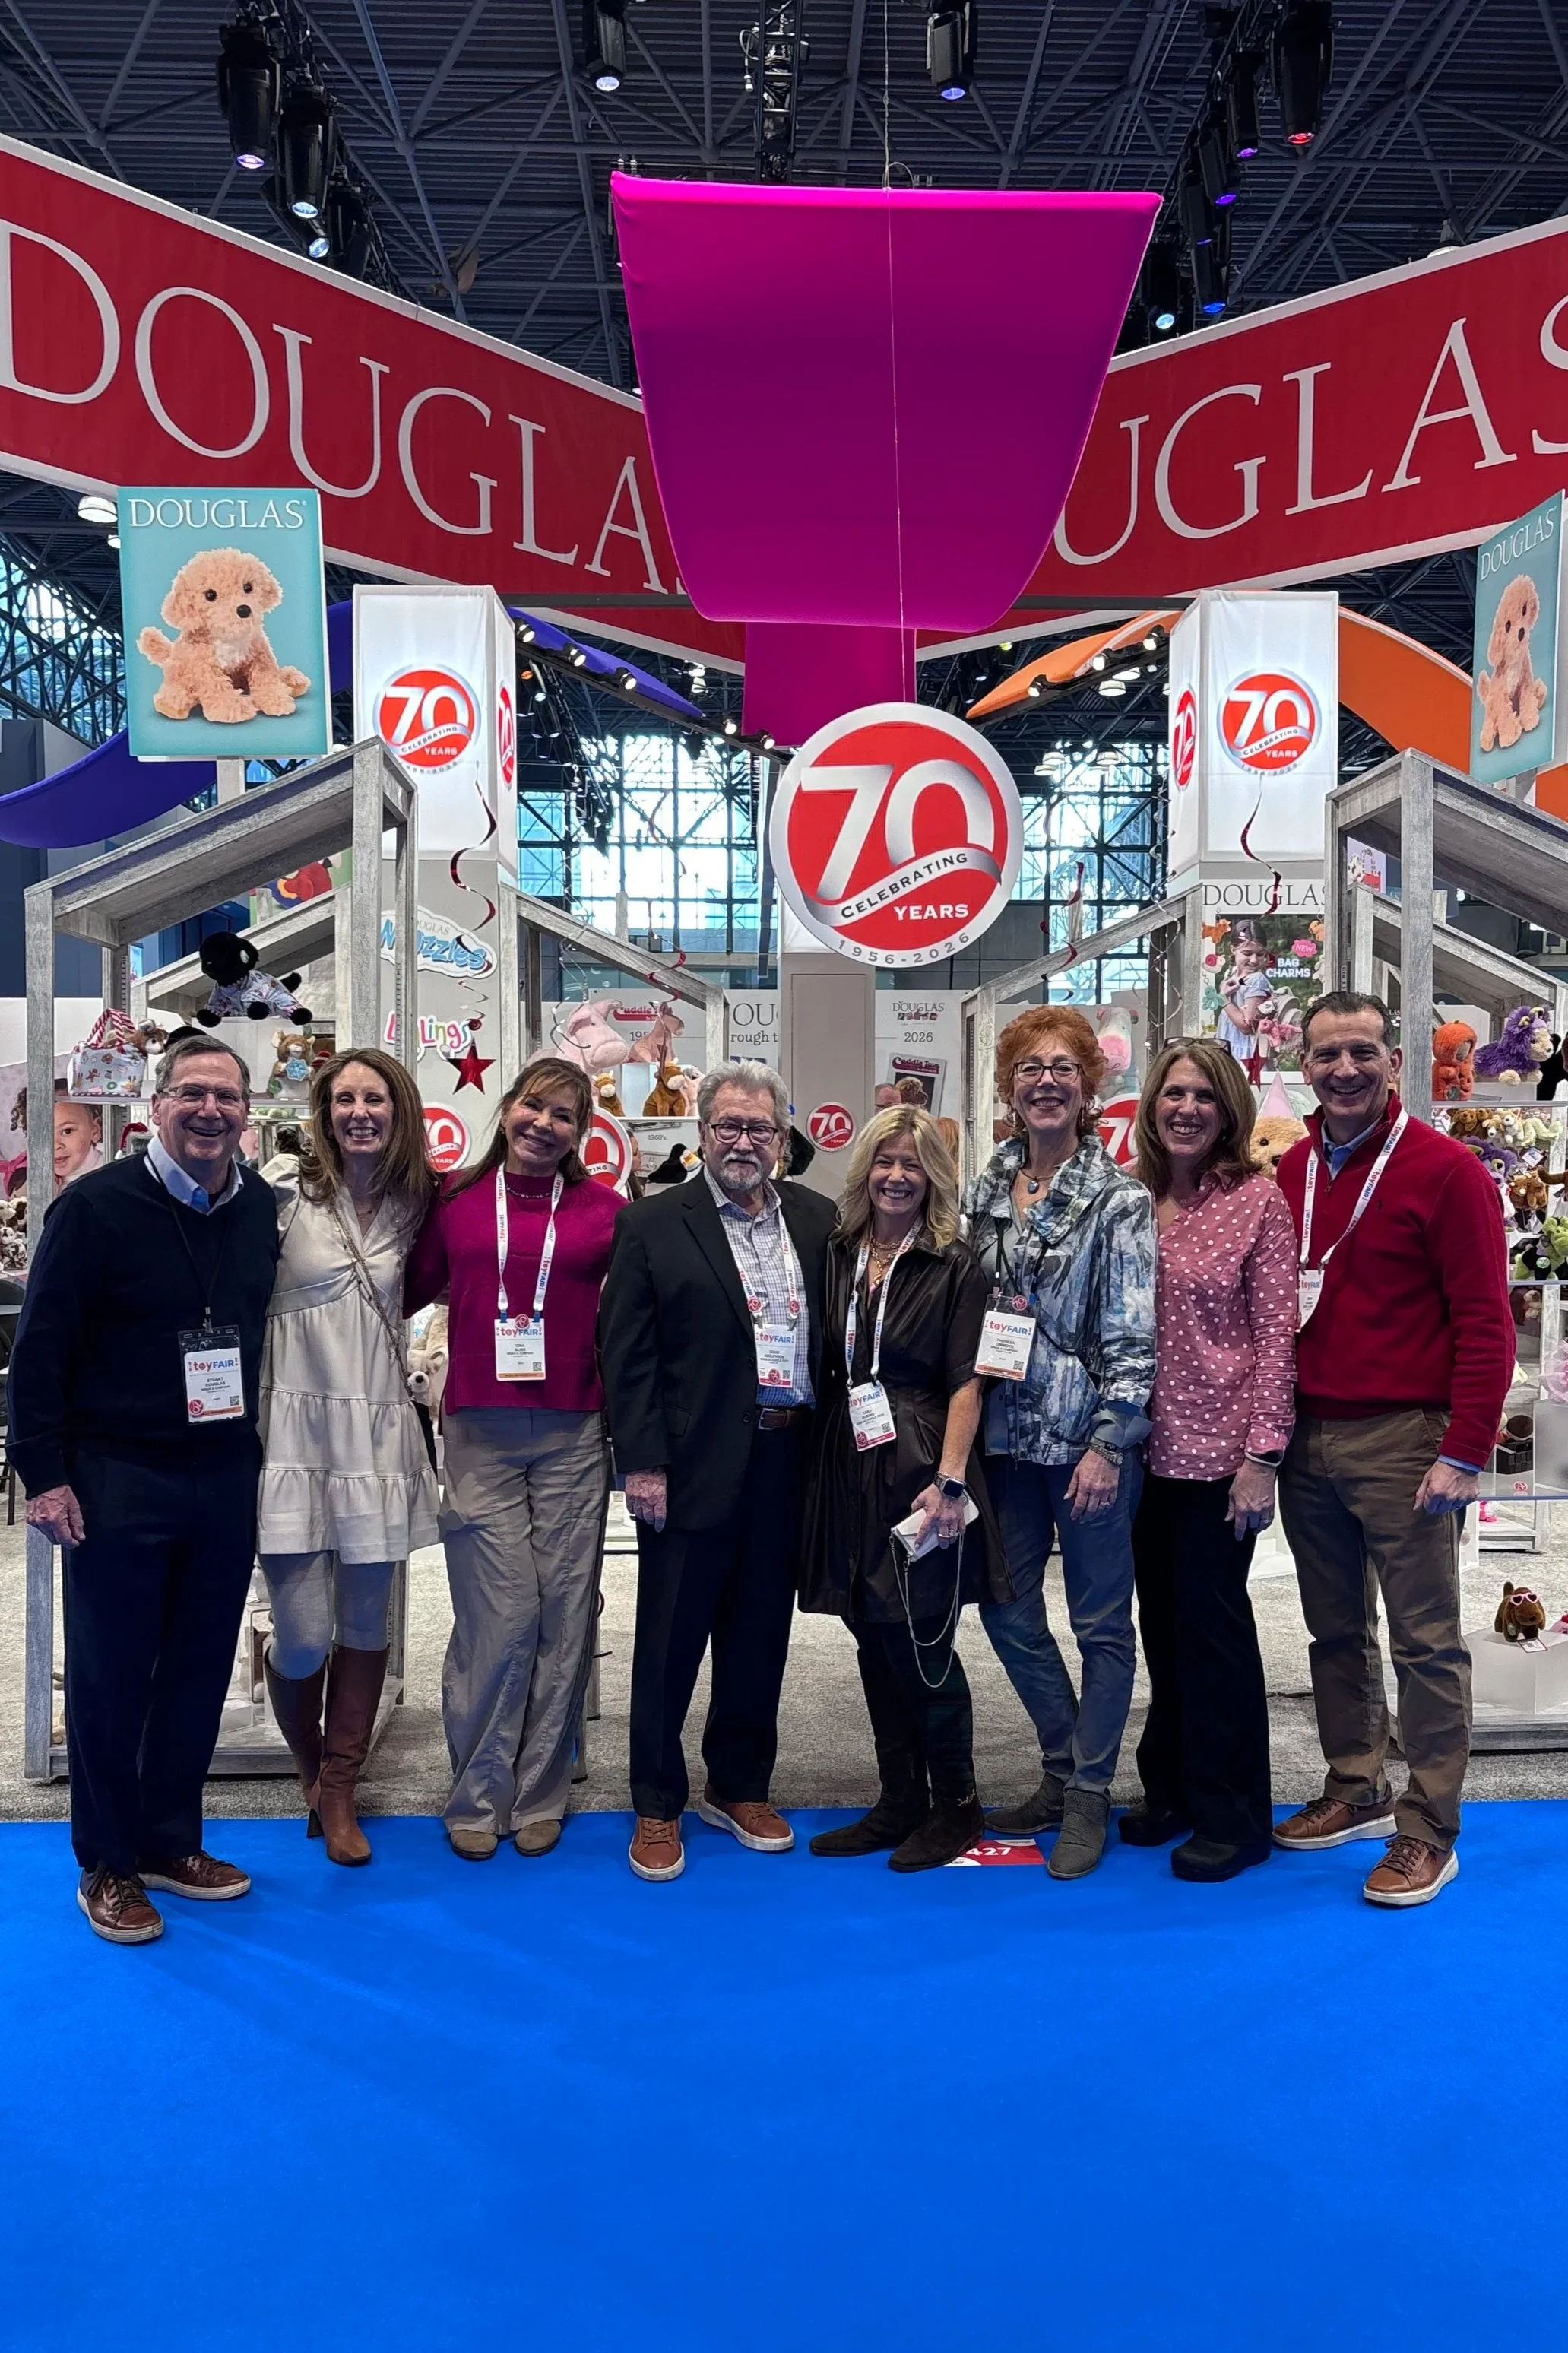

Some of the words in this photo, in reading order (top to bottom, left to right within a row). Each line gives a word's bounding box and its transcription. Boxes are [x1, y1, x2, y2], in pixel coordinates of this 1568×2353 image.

[0, 218, 687, 595] DOUGLA
[1053, 294, 1568, 565] UGLA
[128, 498, 304, 528] DOUGLAS
[1480, 507, 1555, 581] DOUGLAS
[385, 685, 469, 744] 70
[1229, 689, 1310, 747] 70
[401, 726, 458, 753] CELEBRATING
[424, 747, 458, 756] YEARS
[1243, 728, 1298, 756] CELEBRATING
[1265, 750, 1298, 759] YEARS
[800, 759, 995, 900] 70
[841, 853, 968, 918] CELEBRATING
[894, 903, 968, 921] YEARS
[838, 932, 969, 965] 1956-2026
[1295, 943, 1314, 953] NEW
[1265, 968, 1311, 978] CHARMS
[1277, 958, 1300, 968] BAG
[892, 1001, 945, 1012] DOUGLAS
[730, 1032, 769, 1047] rough
[904, 1032, 933, 1042] 2026
[811, 1112, 851, 1138] 70
